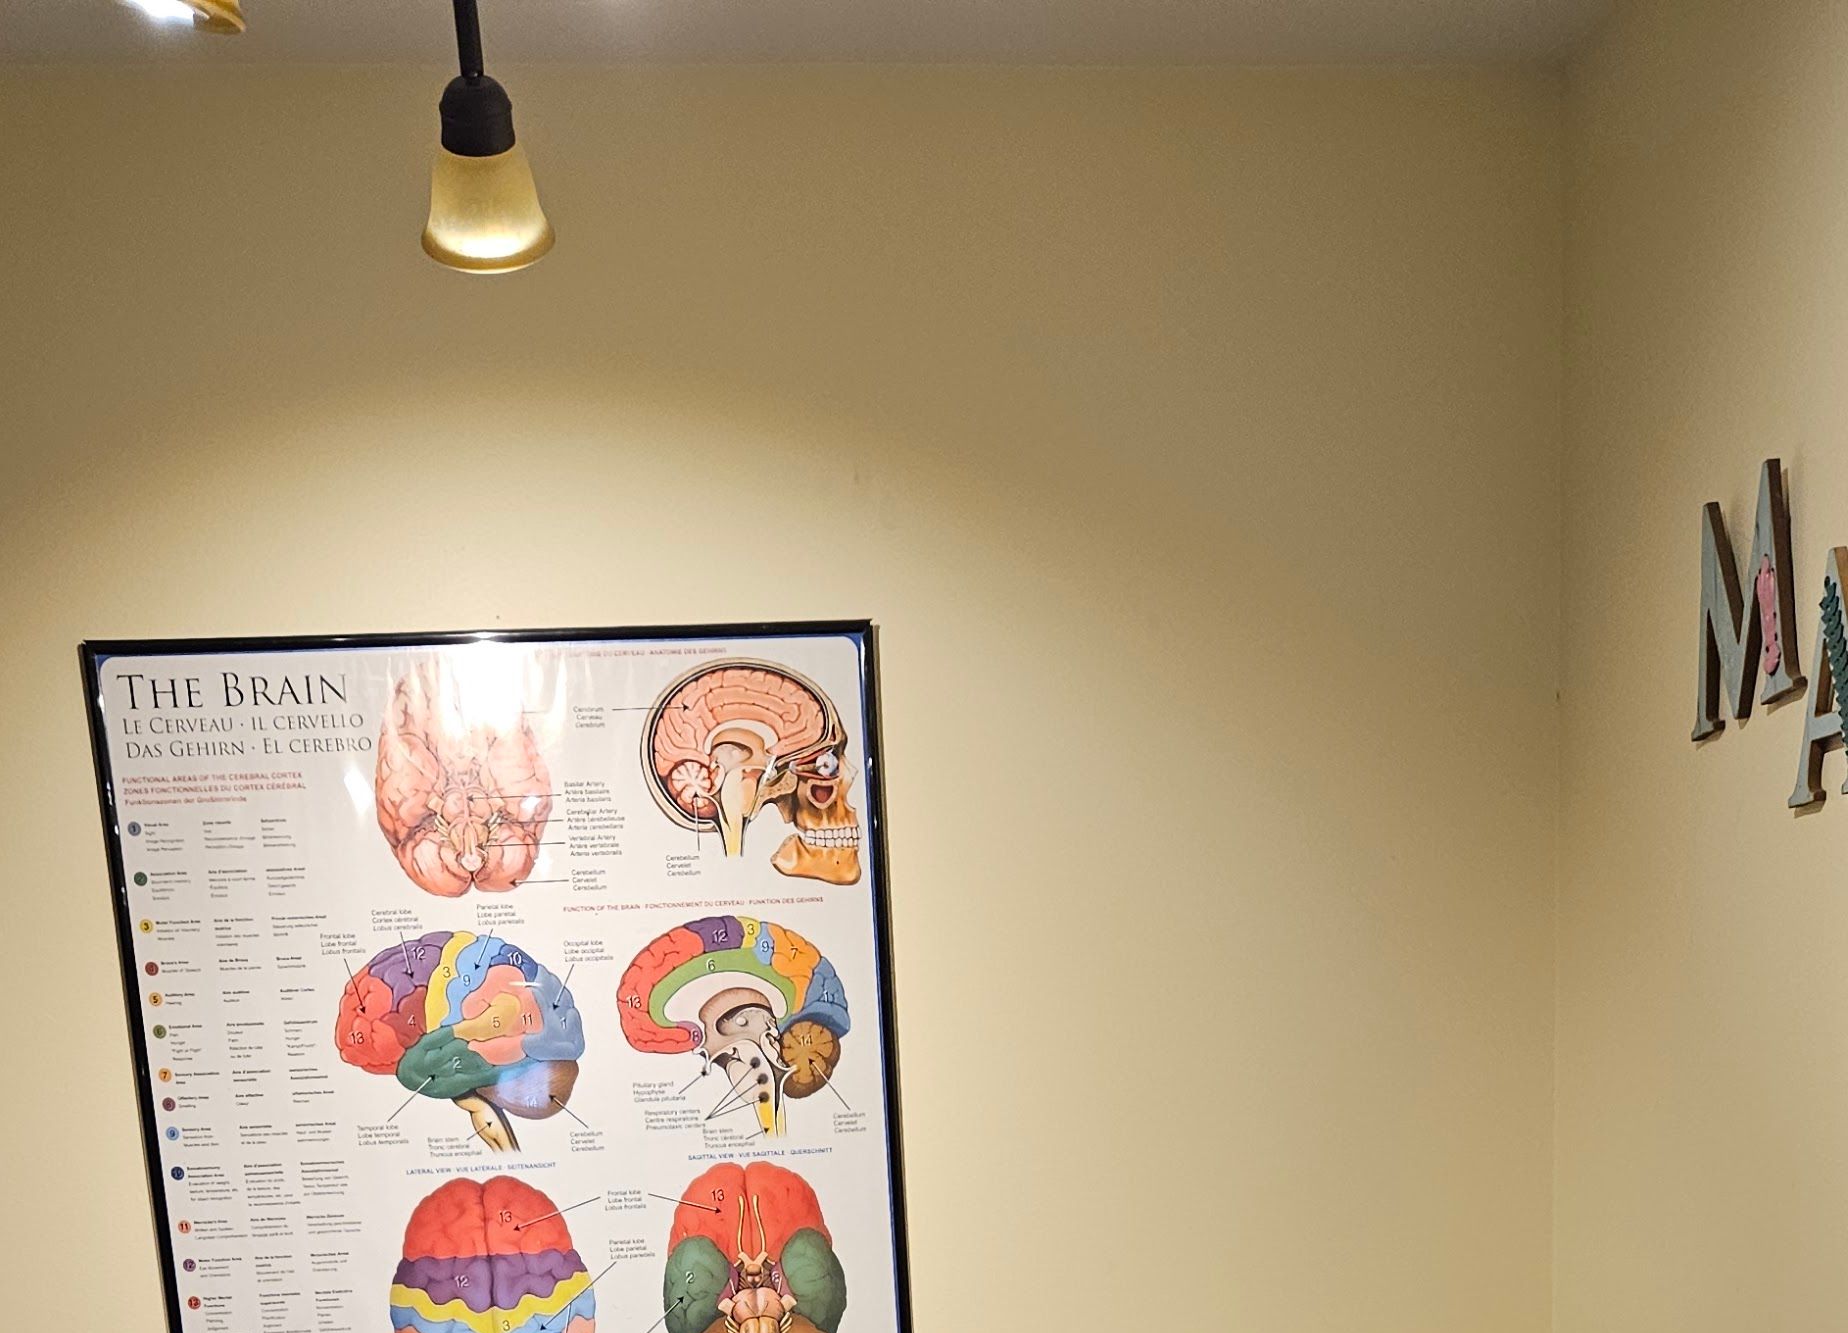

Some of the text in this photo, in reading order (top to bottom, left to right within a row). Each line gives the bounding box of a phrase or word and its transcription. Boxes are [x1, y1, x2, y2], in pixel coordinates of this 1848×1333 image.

[117, 672, 348, 710] THE BRAIN
[123, 713, 364, 735] LE CERVEAU IL CERVELLO
[126, 737, 372, 759] DAS GEHIRN EL CEREBRO
[122, 776, 170, 785] FUNCTIONAL
[173, 775, 197, 783] AREAS
[212, 774, 226, 782] THE
[229, 773, 269, 781] CEREBRAL
[272, 772, 302, 780] CORTEX
[714, 930, 727, 942] 12
[747, 924, 755, 936] 3
[762, 941, 769, 952] 9
[411, 947, 425, 960] 12
[508, 953, 522, 965] 10
[791, 948, 798, 960] 7
[708, 959, 716, 971] 6
[443, 967, 451, 979] 3
[463, 975, 470, 986] 9
[627, 997, 641, 1008] 13
[408, 1015, 415, 1027] 4
[493, 1017, 500, 1028] 5
[522, 1014, 533, 1026] 11
[560, 1018, 567, 1029] 1
[351, 1033, 364, 1044] 13
[692, 1031, 700, 1041] 8
[800, 1035, 812, 1047] 14
[453, 1057, 462, 1069] 2
[712, 1189, 725, 1201] 13
[500, 1211, 512, 1223] 13
[456, 1276, 469, 1288] 12
[686, 1272, 695, 1284] 2
[503, 1320, 510, 1331] 3
